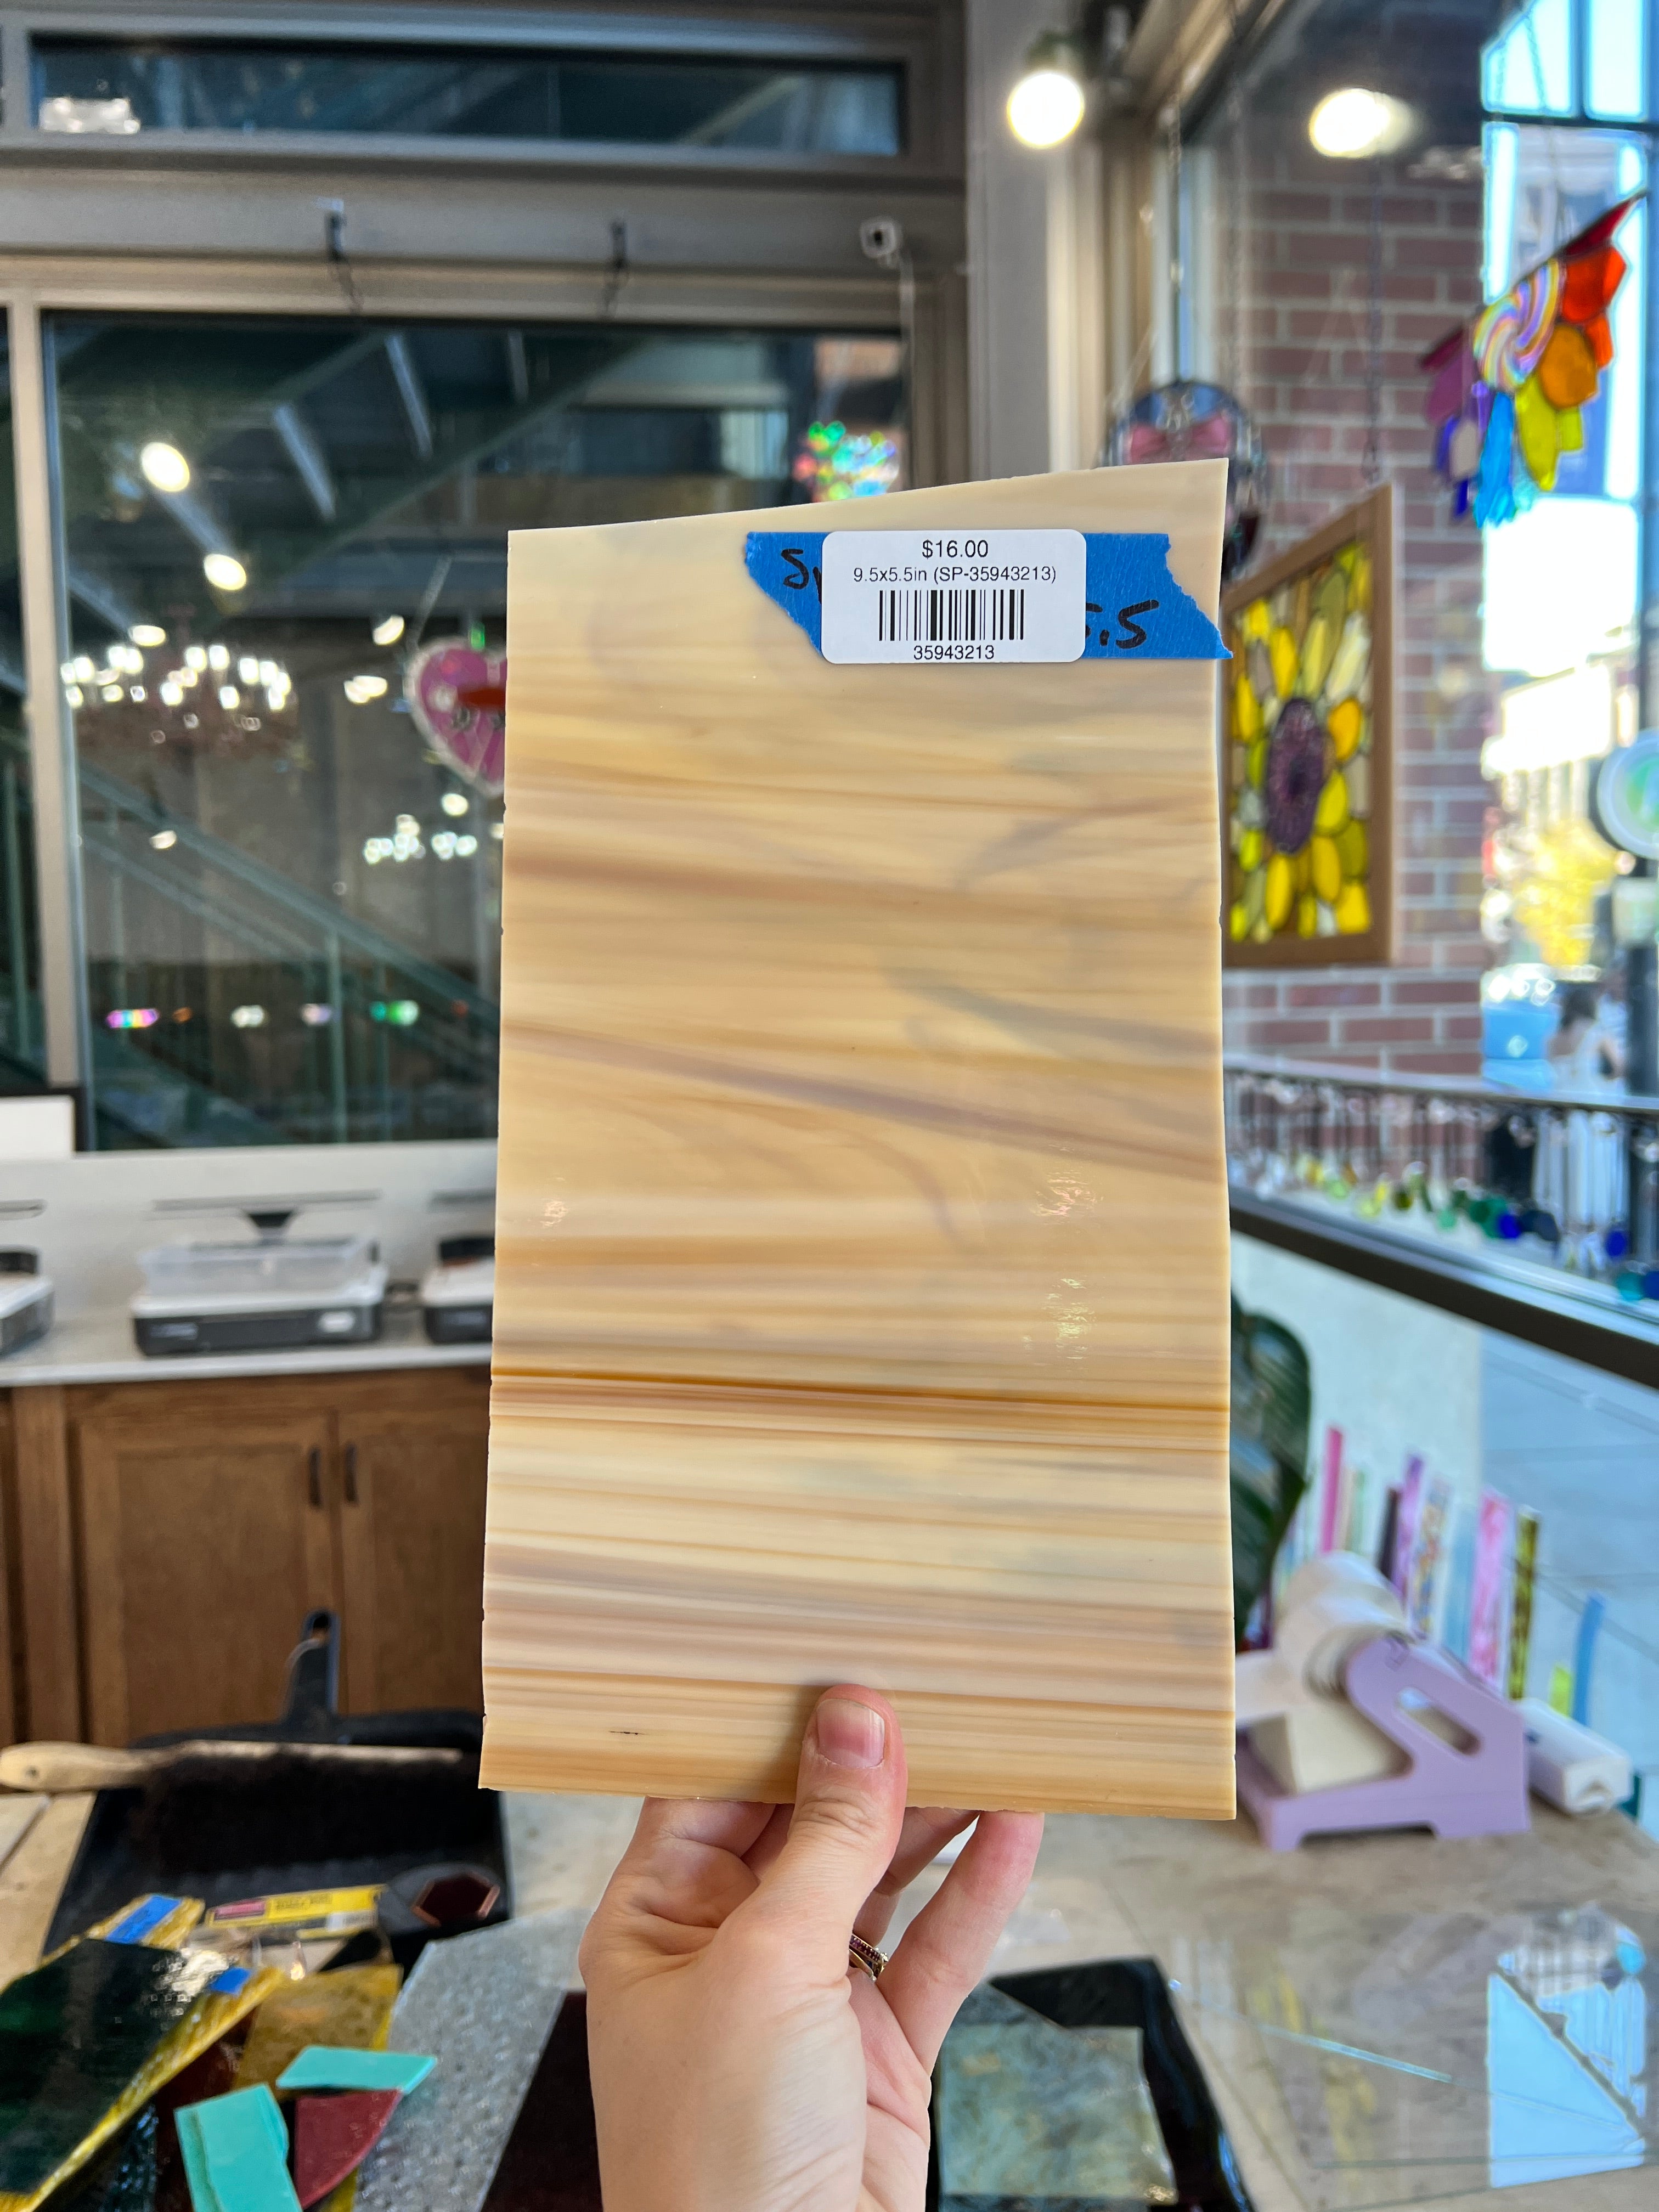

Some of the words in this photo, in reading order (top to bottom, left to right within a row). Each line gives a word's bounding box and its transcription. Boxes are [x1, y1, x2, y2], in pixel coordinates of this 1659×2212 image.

[922, 539, 989, 560] $16.00
[854, 567, 927, 583] 9.5x5.5in
[934, 566, 1056, 585] (SP-35943213)
[913, 645, 994, 660] 35943213
